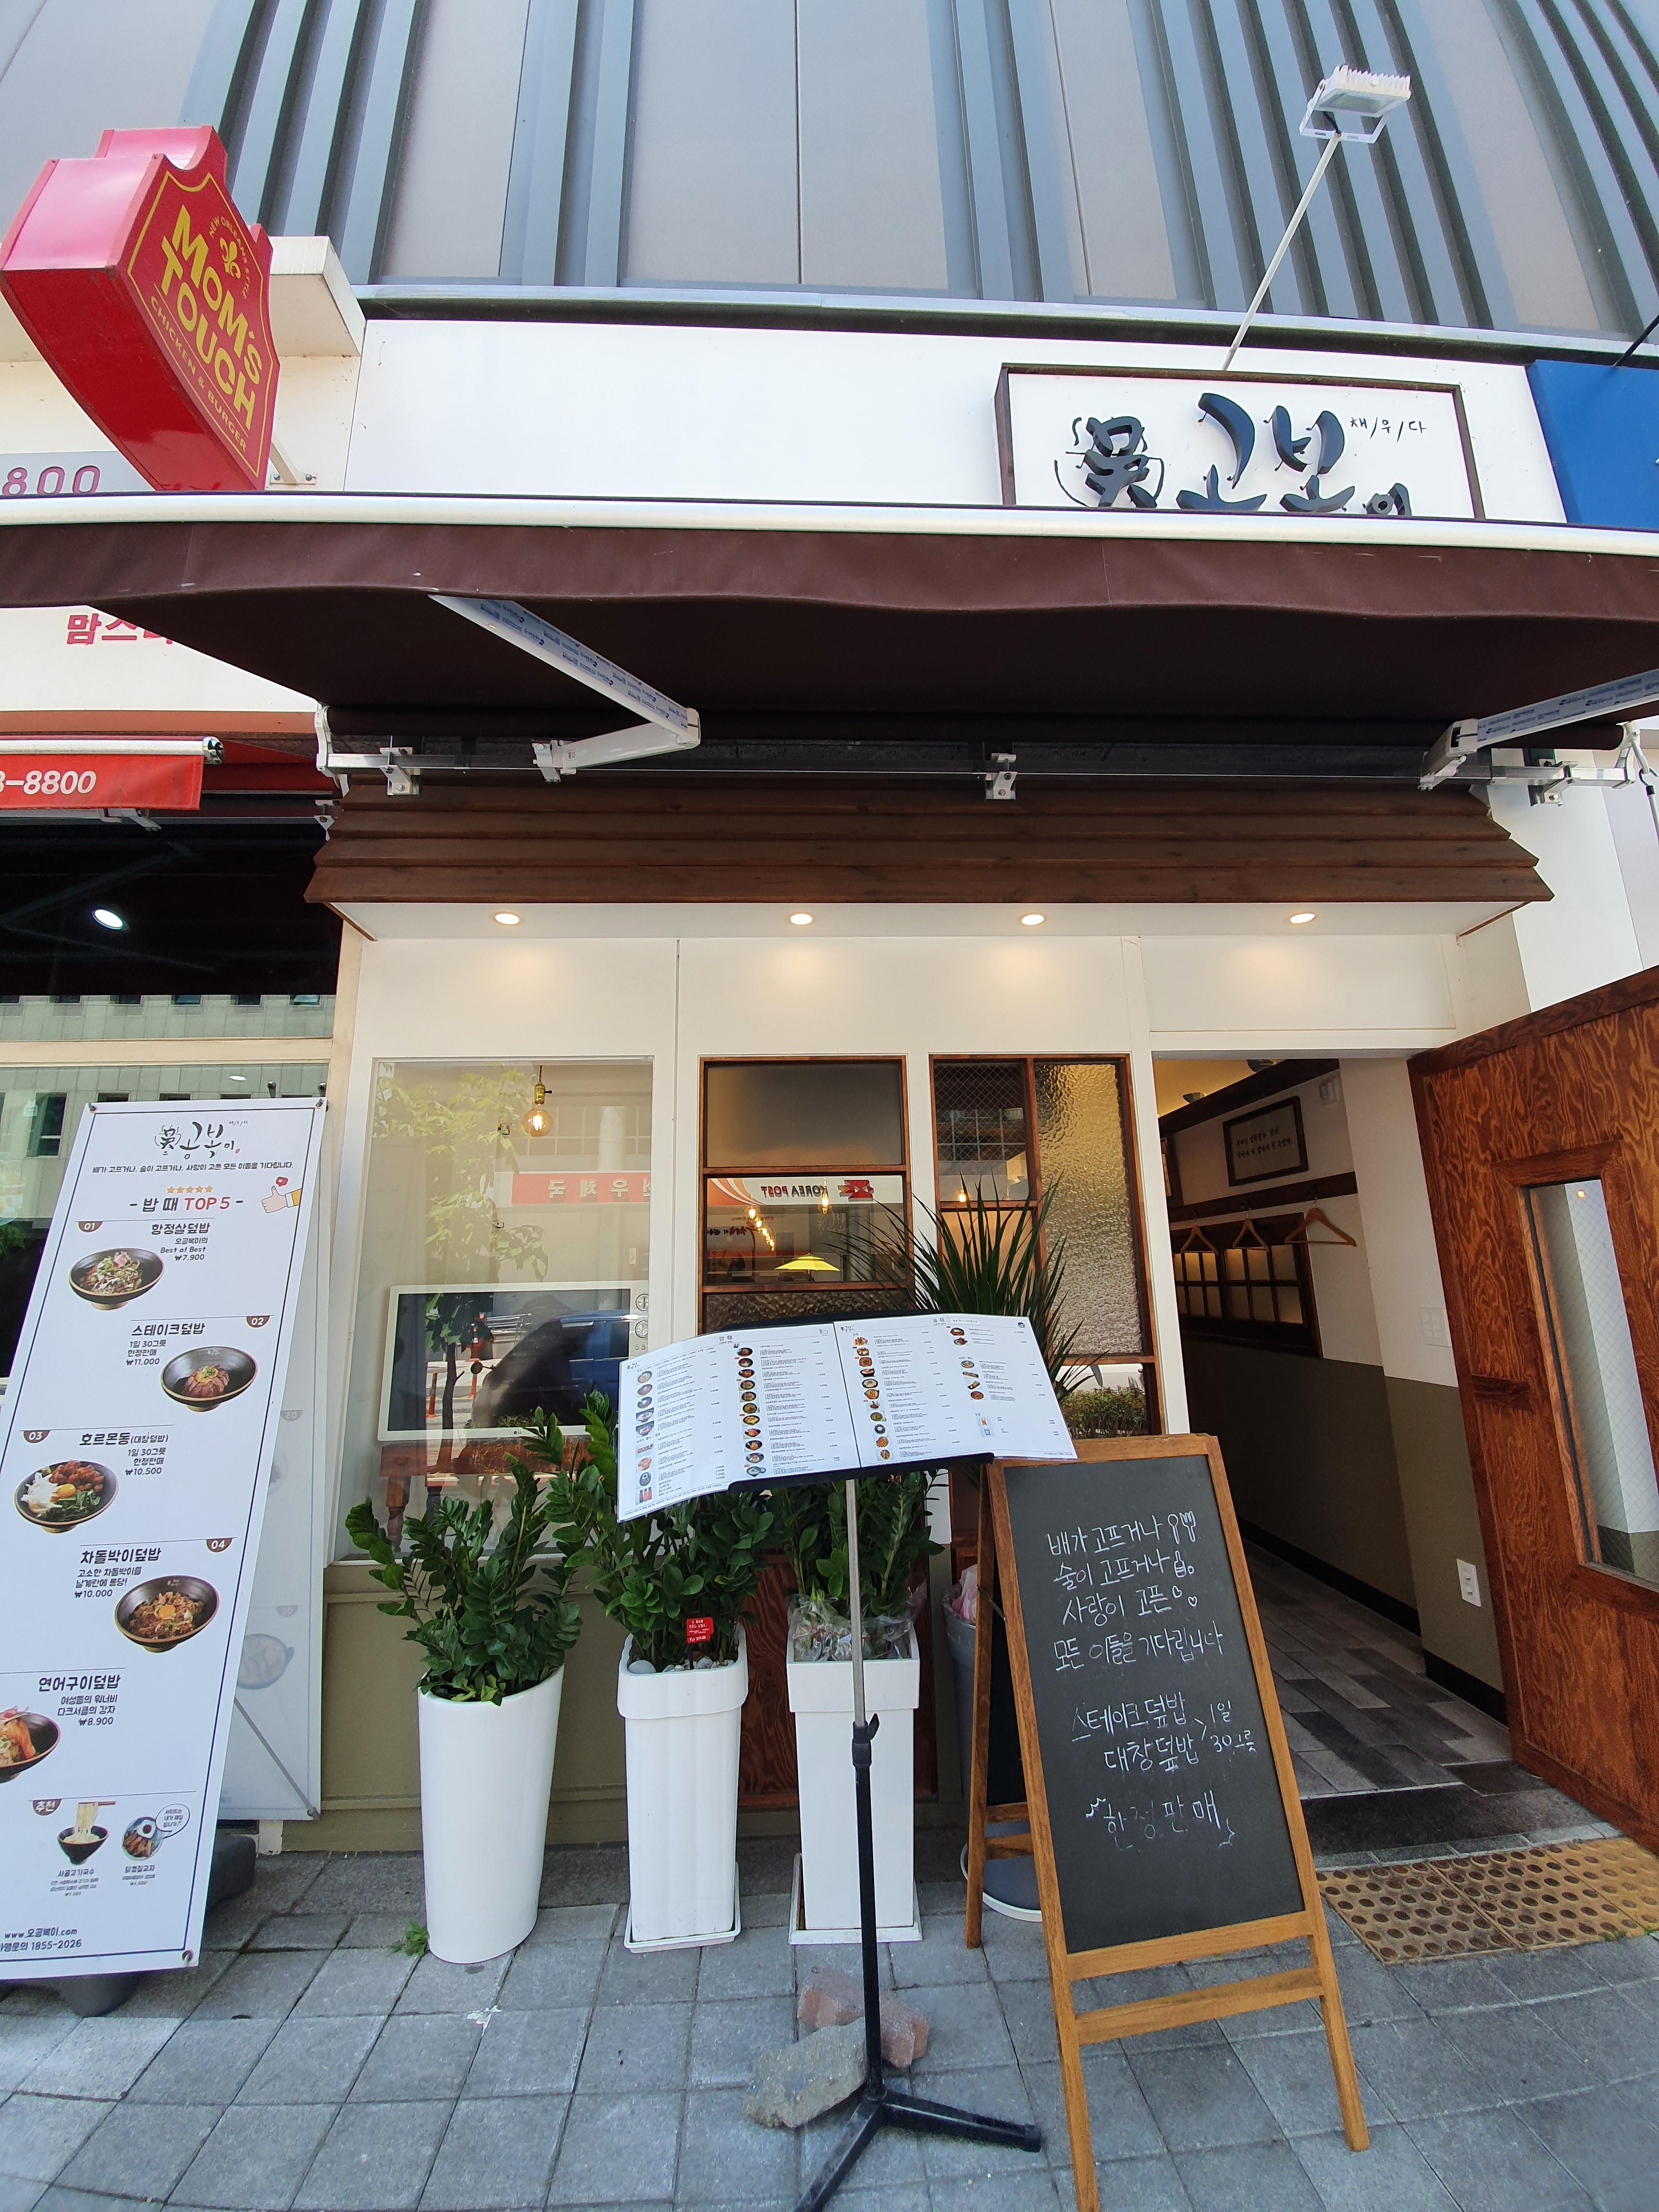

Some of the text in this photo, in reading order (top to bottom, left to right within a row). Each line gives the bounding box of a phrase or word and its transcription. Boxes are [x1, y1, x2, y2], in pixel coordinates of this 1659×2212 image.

[209, 216, 220, 239] NEW
[172, 204, 263, 385] MOM'S
[161, 235, 256, 431] TOUCH
[151, 296, 246, 452] CHICKEN & BURGER
[67, 613, 173, 644] 맘스
[142, 1197, 159, 1212] 밥
[162, 1197, 179, 1211] 때
[84, 1222, 96, 1231] 01
[151, 1222, 211, 1236] 항정살덮밥
[174, 1237, 208, 1245] 오공복이의
[251, 1317, 264, 1326] 02
[131, 1322, 205, 1336] 스테이크덮밥
[129, 1339, 167, 1348] 1일 30그릇
[127, 1348, 157, 1358] 한정판매
[28, 1431, 43, 1441] 03
[127, 1447, 167, 1457] 1일 30그릇
[133, 1457, 165, 1466] 한정판매
[1046, 1515, 1164, 1556] 배가 고프거나
[210, 1539, 226, 1550] 04
[80, 1547, 162, 1564] 차돌박이덮밥
[77, 1566, 142, 1577] 고소한 차돌박이를
[1053, 1548, 1171, 1591] 술이 고프거나
[75, 1577, 128, 1588] 날계란에 퐁당!
[1062, 1584, 1173, 1627] 사랑이 고픈
[1053, 1620, 1224, 1671] 모든 이들을 기다립니다
[38, 1674, 121, 1692] 연어구이덮밥
[60, 1694, 118, 1705] 여성들의 워너비
[57, 1705, 116, 1716] 다크서클의 강자
[35, 1800, 56, 1813] 추천
[31, 1938, 82, 1950] 1855-2026
